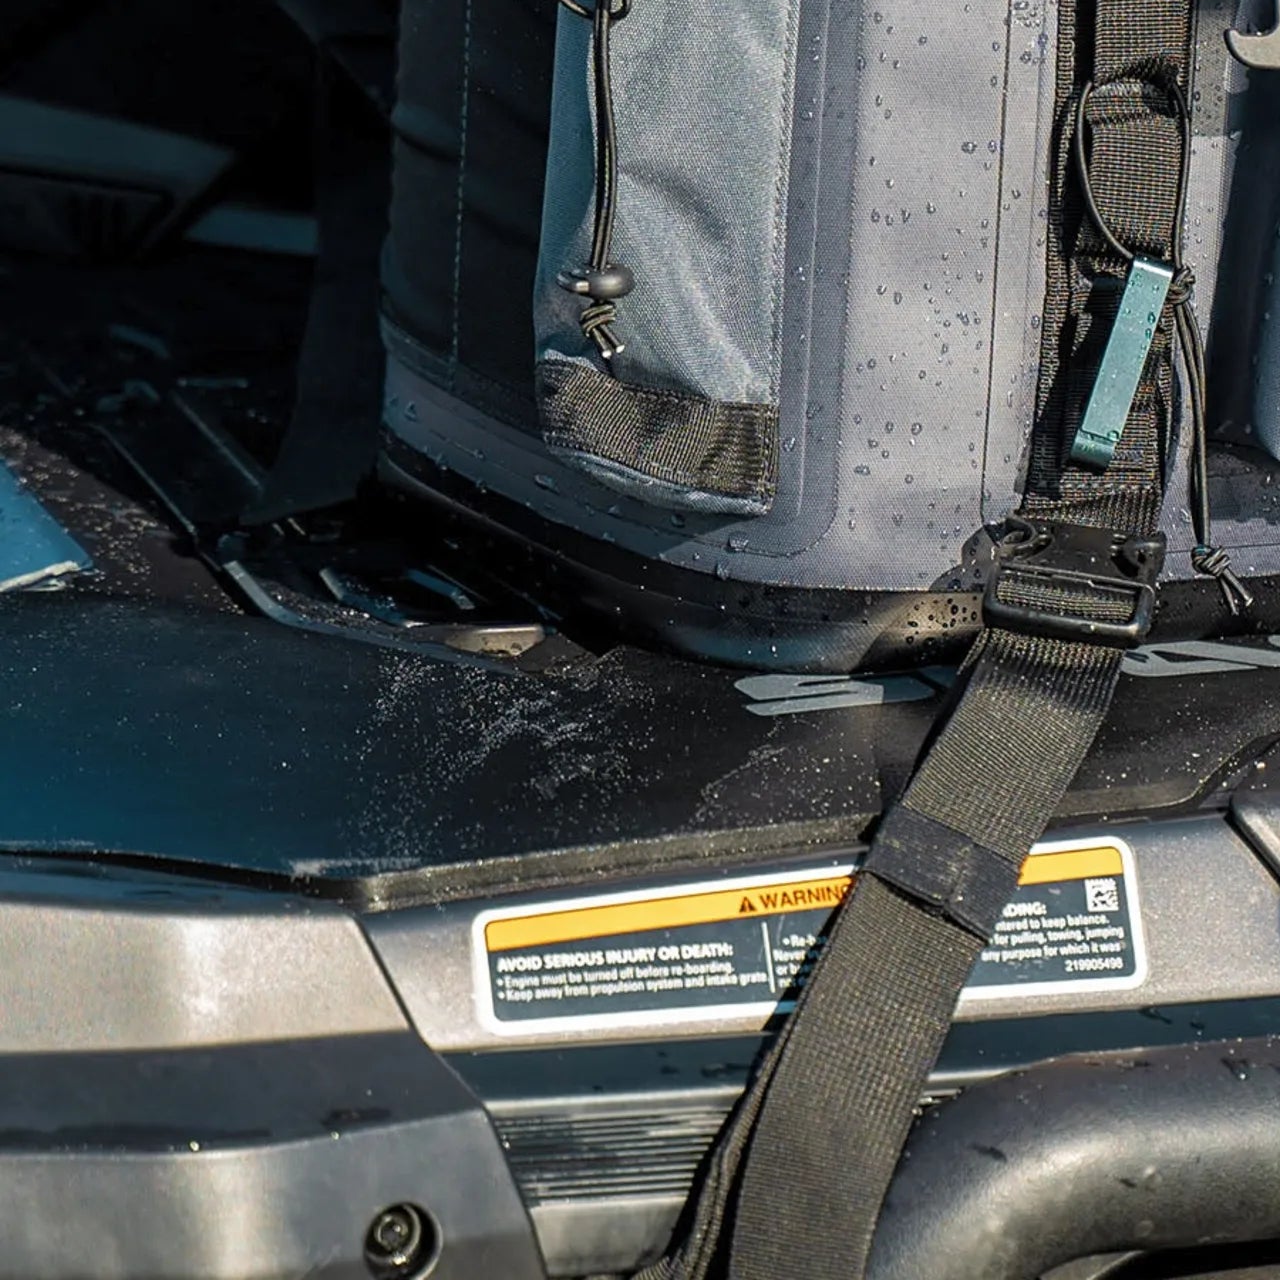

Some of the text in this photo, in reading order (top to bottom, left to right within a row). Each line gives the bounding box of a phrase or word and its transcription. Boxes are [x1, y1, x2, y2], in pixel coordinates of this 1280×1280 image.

[1030, 920, 1040, 929] to
[1042, 918, 1065, 928] keep
[1067, 915, 1109, 926] balance.
[994, 935, 1009, 944] for
[1085, 926, 1124, 939] jumping
[498, 942, 733, 972] AVOID SERIOUS INJURY OR DEATH:
[1002, 947, 1042, 961] purpose
[1044, 946, 1057, 956] for
[1060, 943, 1089, 955] which
[1092, 942, 1098, 952] it
[1100, 941, 1120, 952] was
[505, 962, 734, 988] Engine must be turned off before re-boarding.
[507, 989, 532, 1002] Keep
[535, 987, 563, 999] away
[564, 985, 589, 996] from
[591, 979, 644, 996] propulsion
[647, 978, 682, 992] system
[686, 977, 704, 987] and
[707, 974, 737, 985] intake
